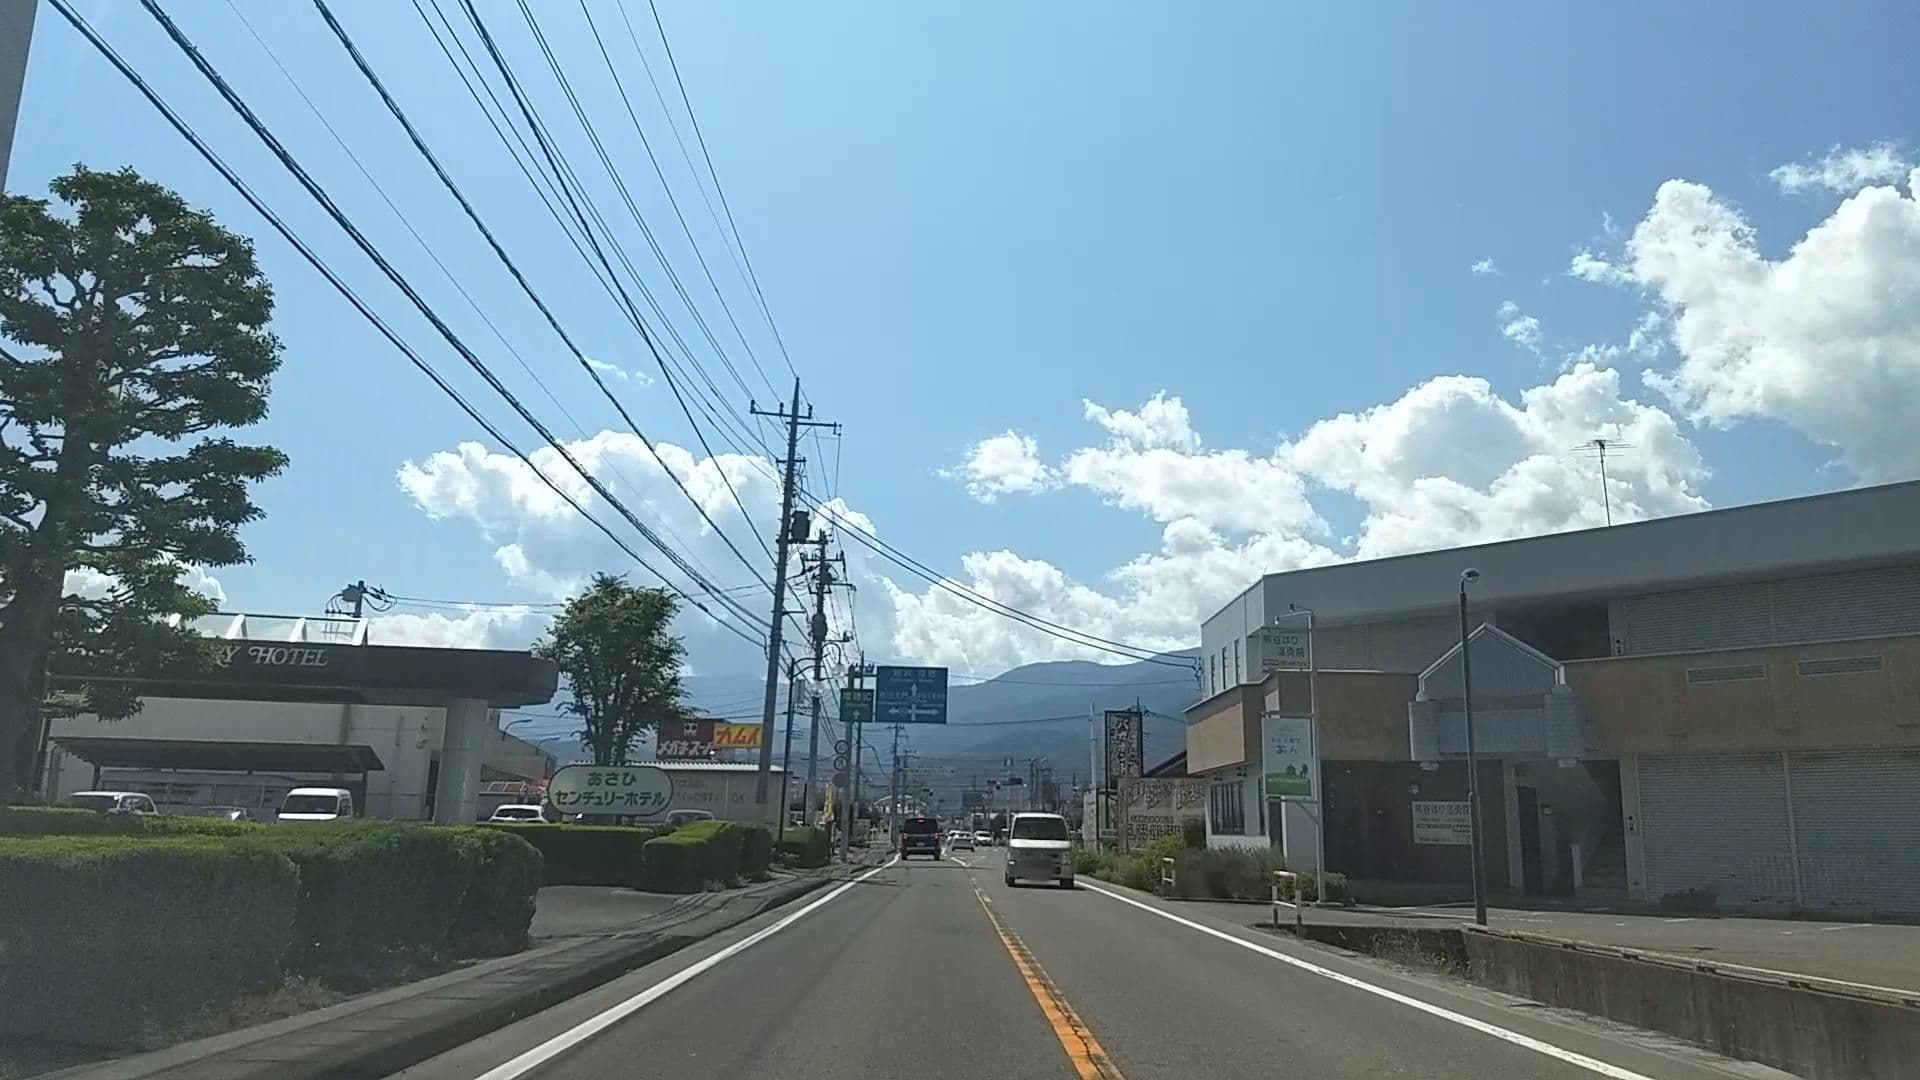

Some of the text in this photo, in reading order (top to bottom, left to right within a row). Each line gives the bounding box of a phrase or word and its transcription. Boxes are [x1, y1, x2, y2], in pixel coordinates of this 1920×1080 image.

[248, 645, 328, 667] HOTEL
[587, 771, 637, 786] あさひ
[554, 790, 666, 806] センチュリーホテル
